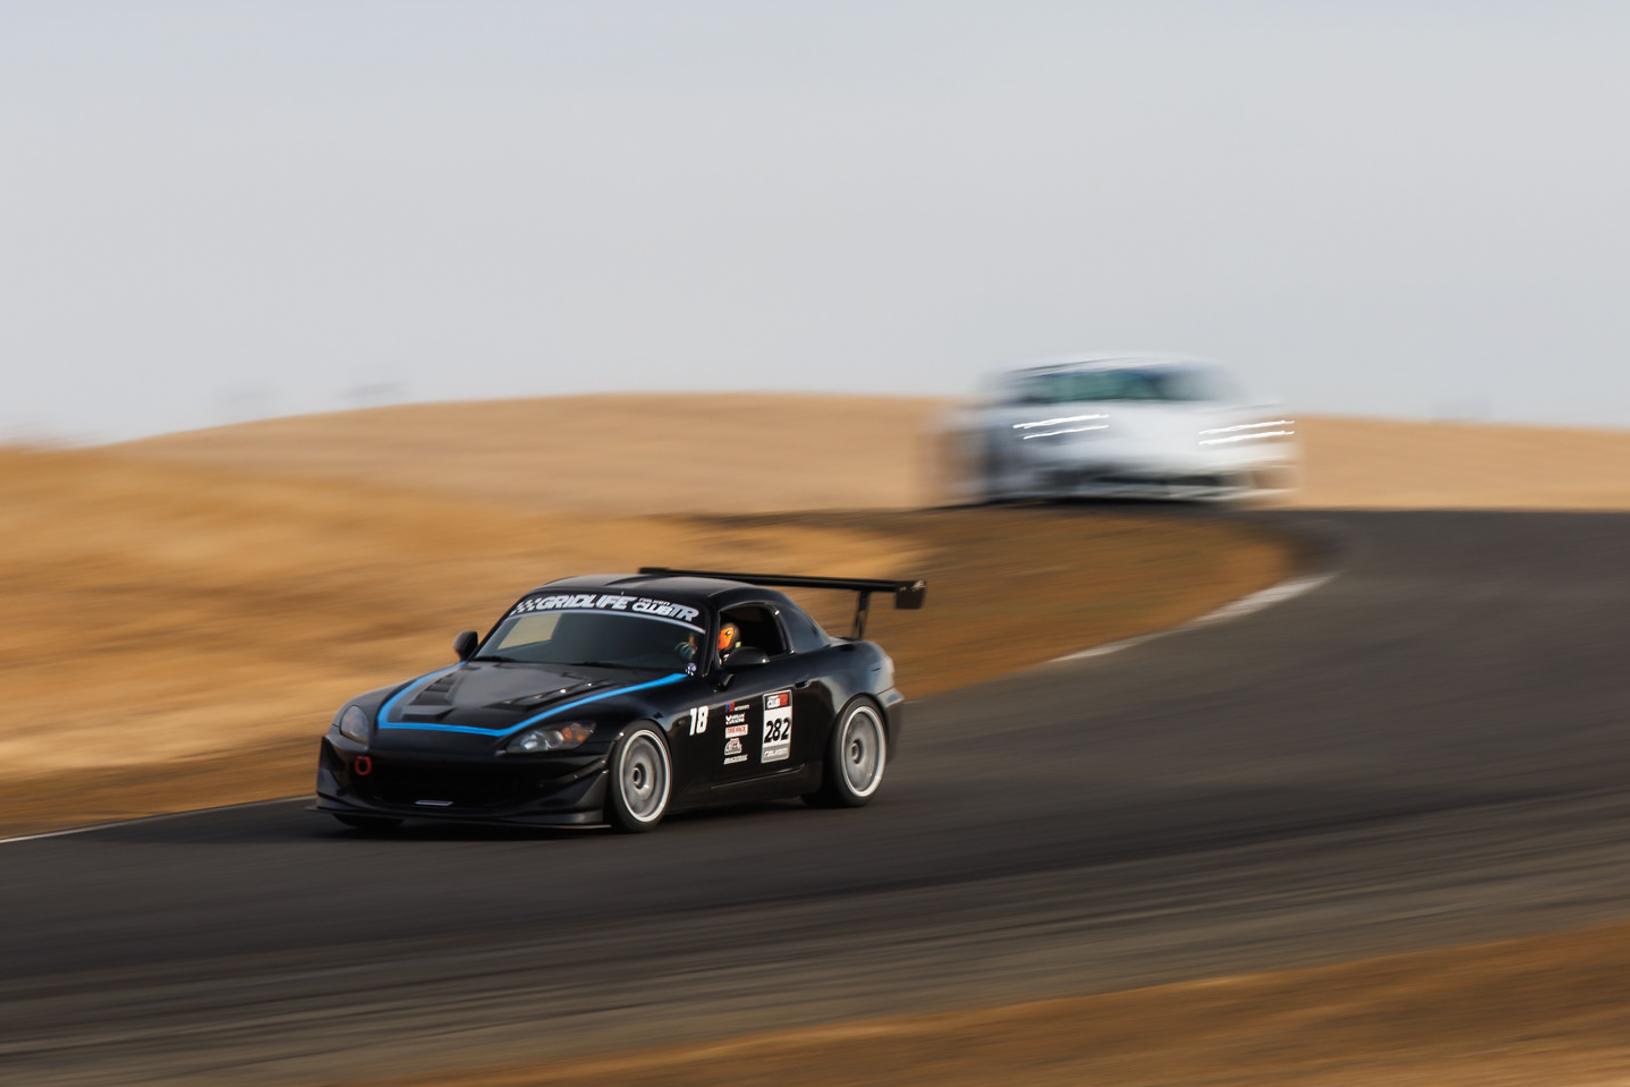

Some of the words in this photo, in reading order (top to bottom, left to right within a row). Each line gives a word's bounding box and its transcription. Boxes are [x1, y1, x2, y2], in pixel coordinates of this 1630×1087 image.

[536, 593, 637, 611] GRIDLIFE
[689, 705, 709, 736] 18
[764, 717, 791, 743] 282
